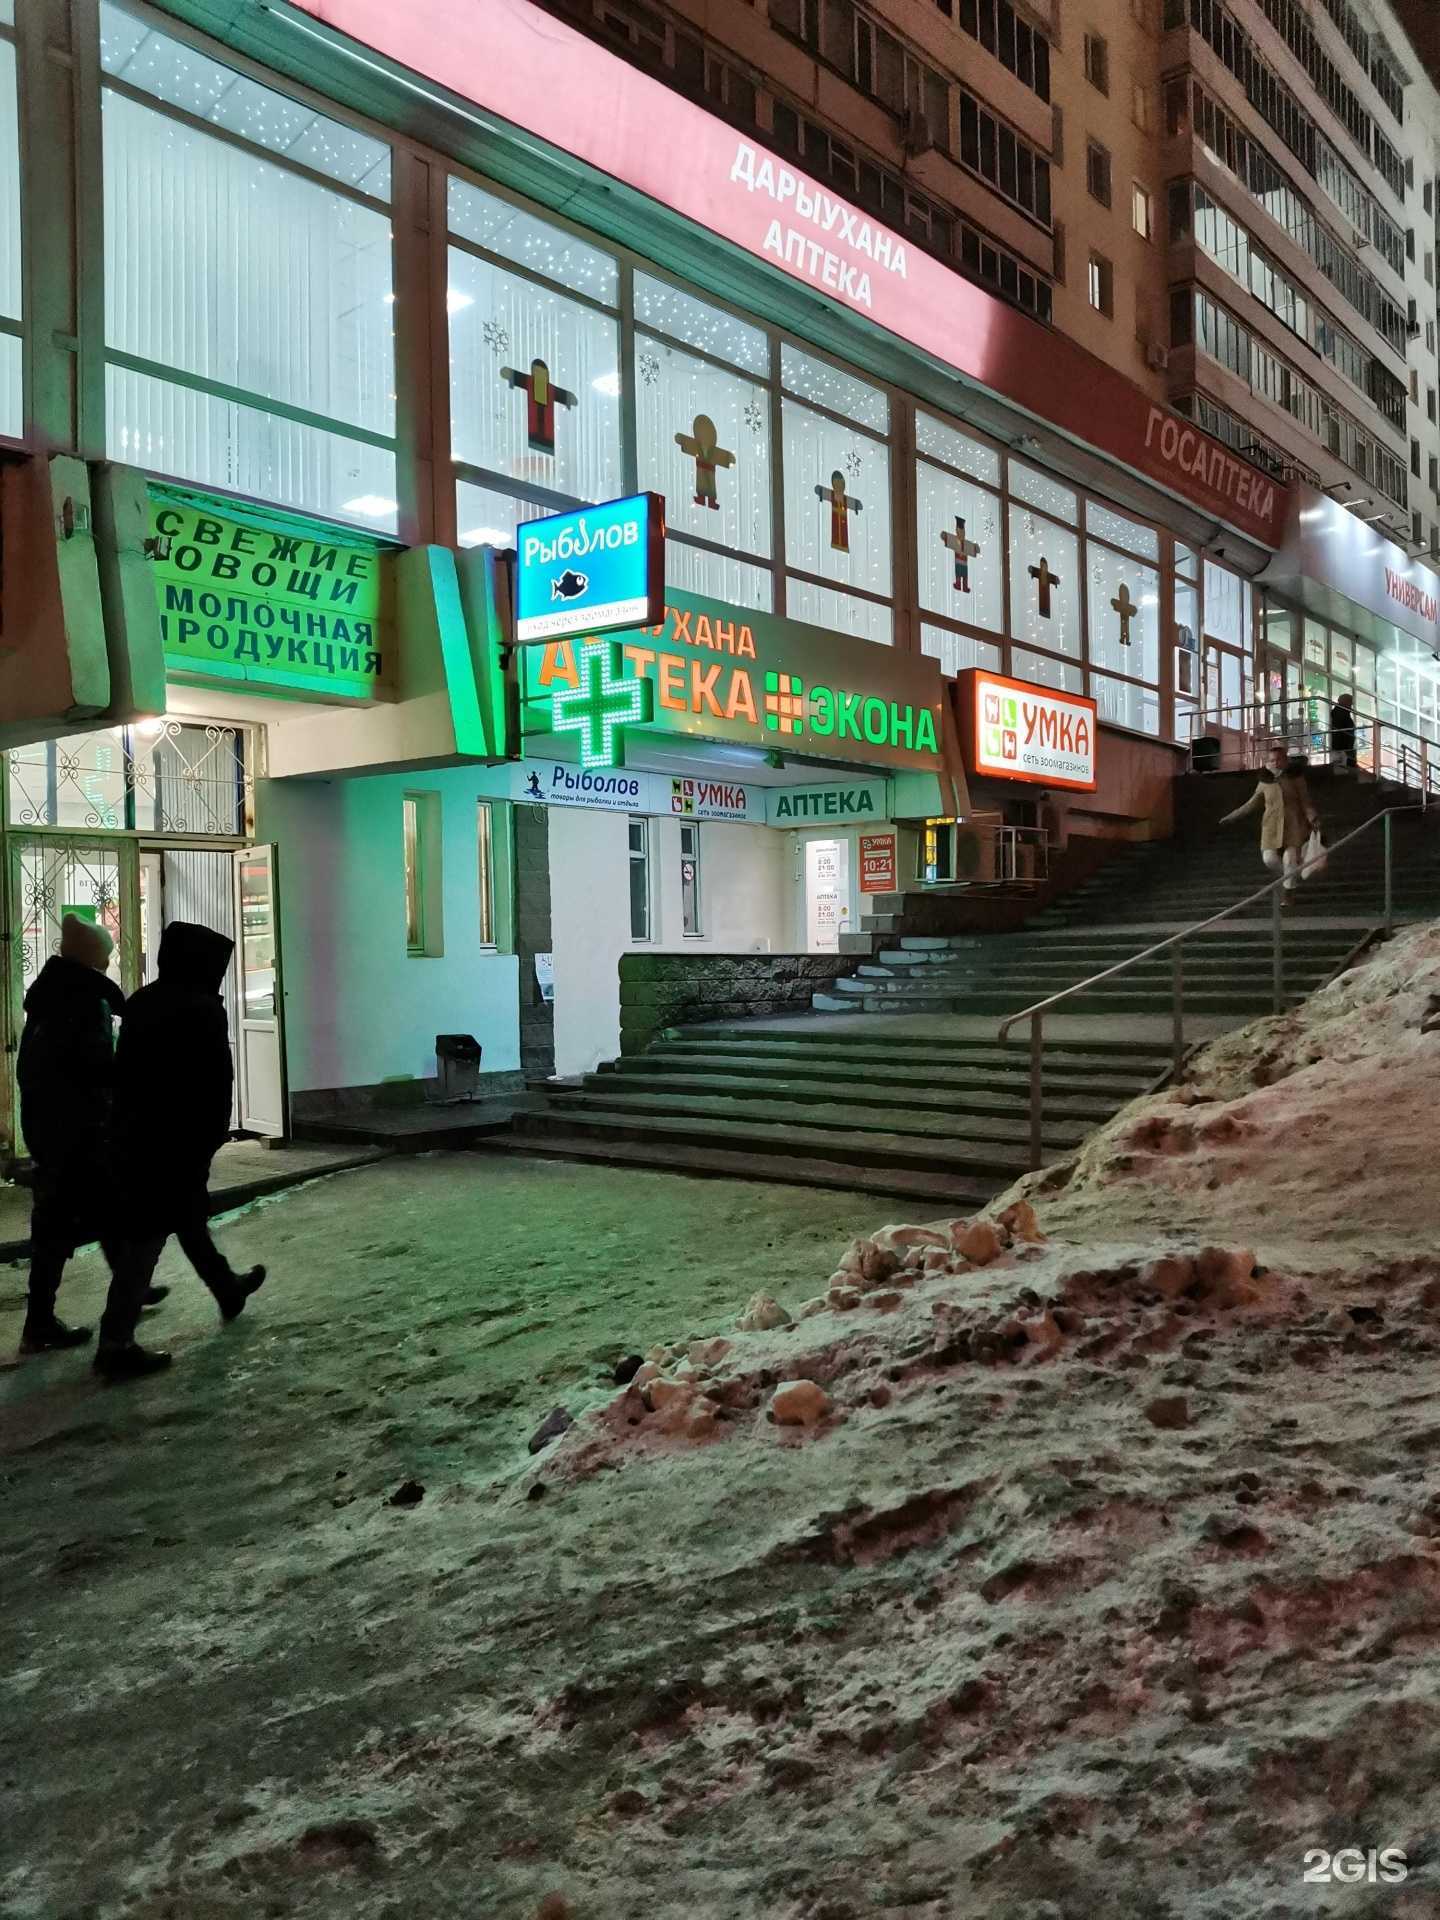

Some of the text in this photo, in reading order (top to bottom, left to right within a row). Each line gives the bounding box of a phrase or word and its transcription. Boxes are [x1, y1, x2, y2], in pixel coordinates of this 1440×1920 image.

[730, 143, 907, 279] ДАРЫУХАНА
[763, 219, 872, 309] АПТЕКА
[1144, 407, 1274, 524] ГОСАПТЕКА
[156, 510, 373, 580] СВЕЖИЕ
[525, 518, 638, 567] Рыболов
[175, 545, 359, 605] ОВОЩИ
[1384, 567, 1438, 625] УНИВЕРСАМ
[166, 585, 374, 647] МОЛОЧНАЯ
[538, 636, 939, 754] АТЕКА ЭКОНА
[1022, 701, 1089, 756] УМКА
[552, 766, 639, 795] Рыболов
[1023, 753, 1039, 765] сеть
[697, 782, 746, 809] УМКА
[776, 790, 873, 817] АПТЕКА
